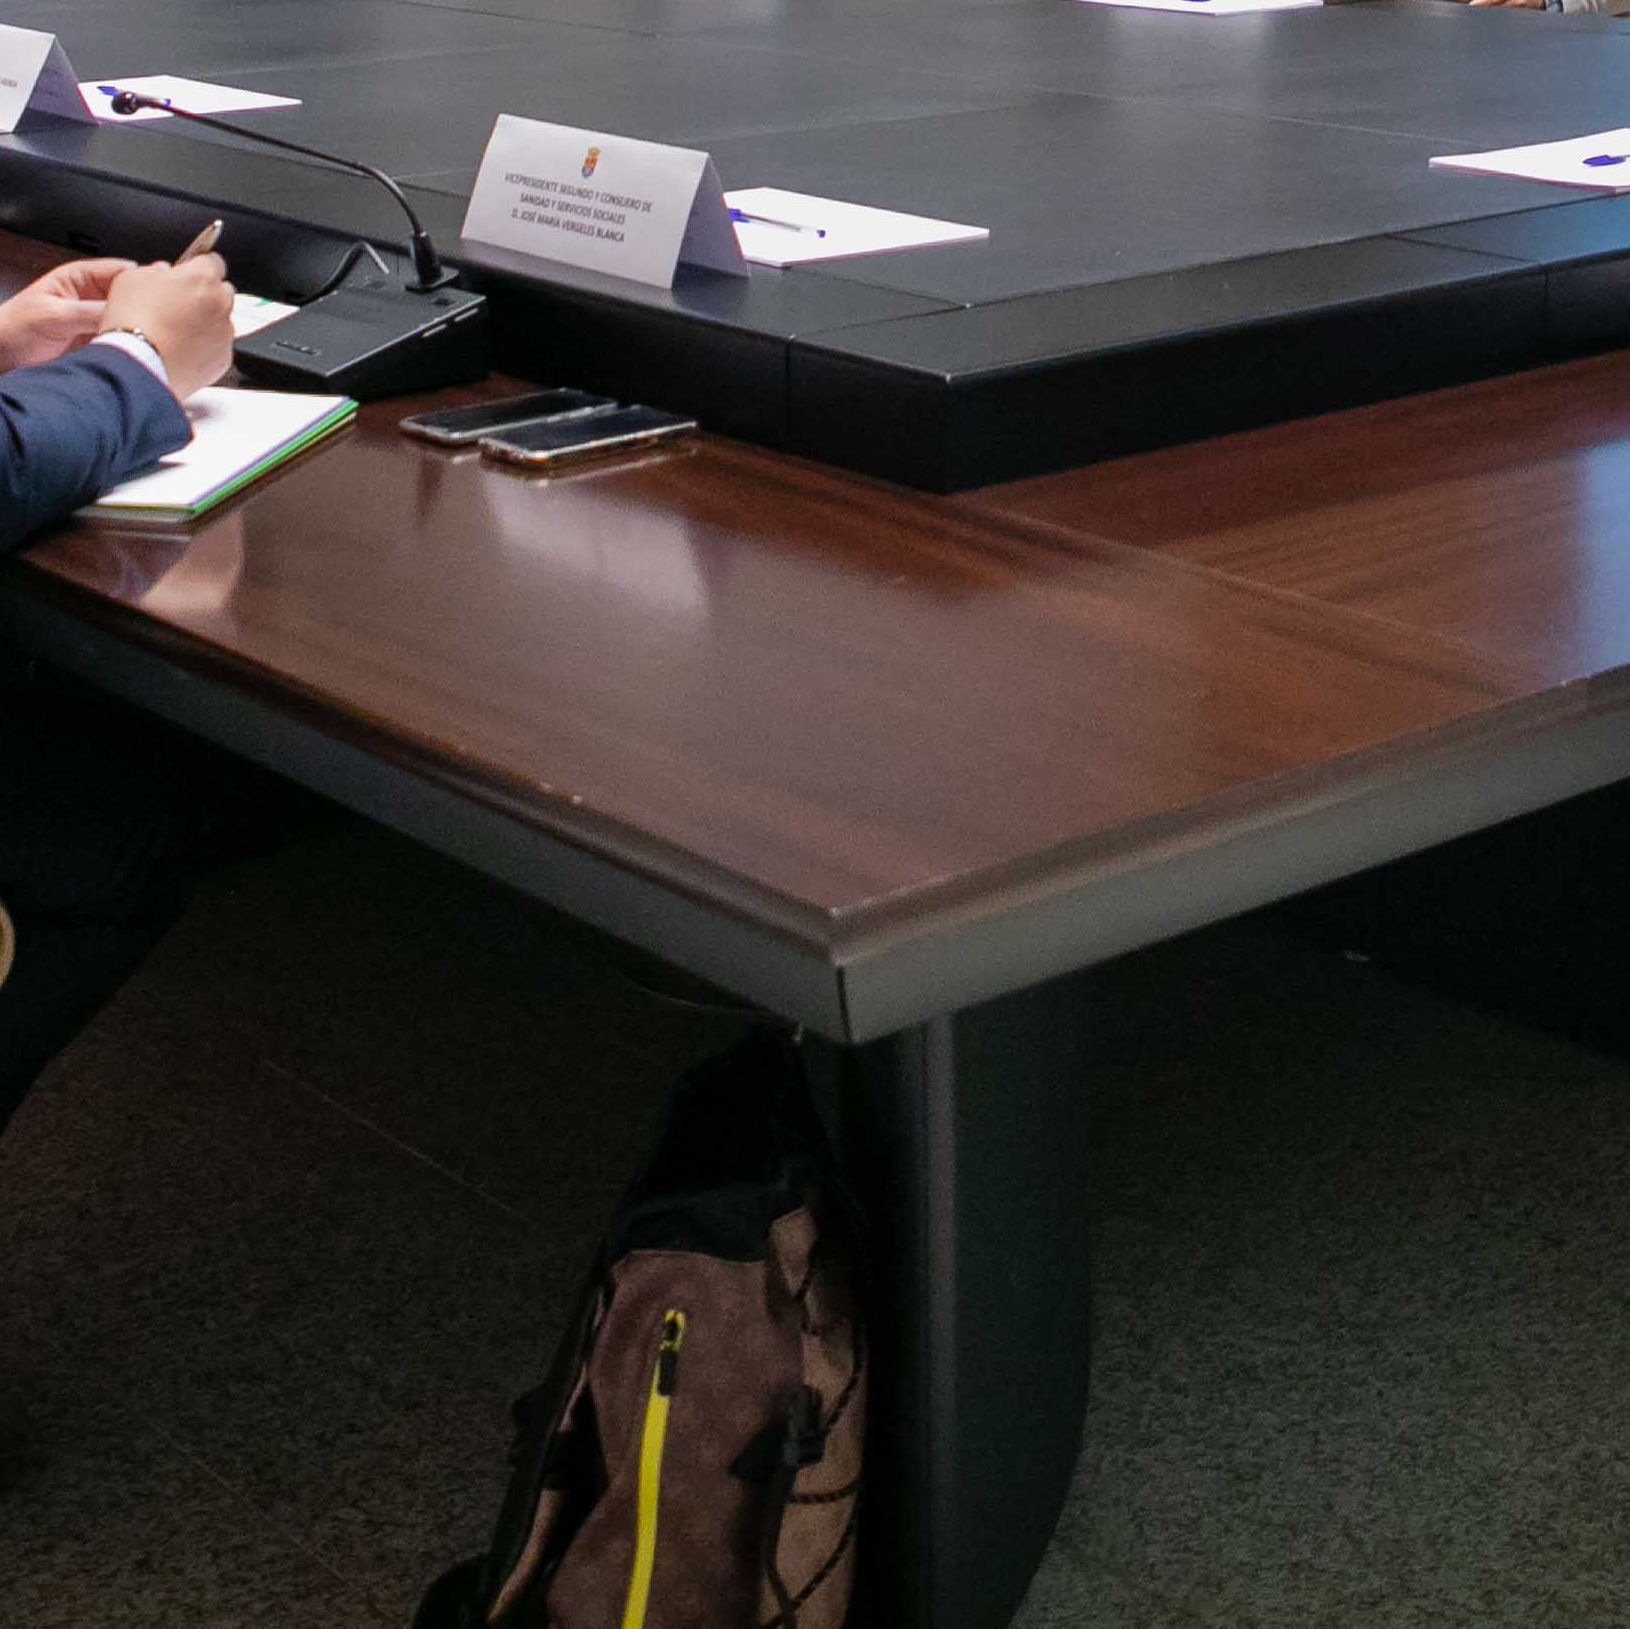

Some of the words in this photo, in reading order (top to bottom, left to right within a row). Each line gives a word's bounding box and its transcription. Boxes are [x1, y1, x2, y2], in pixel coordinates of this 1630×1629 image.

[505, 171, 558, 192] VICEPRESIDENTE
[559, 183, 594, 201] SEGUNDO
[600, 191, 641, 210] CONSEJERO
[642, 202, 652, 212] DE
[520, 192, 550, 208] SANIDAD
[556, 200, 592, 218] SERVICIOS
[593, 207, 626, 224] SOCIALES
[562, 220, 596, 237] VERGELES
[596, 227, 625, 242] BLANCA
